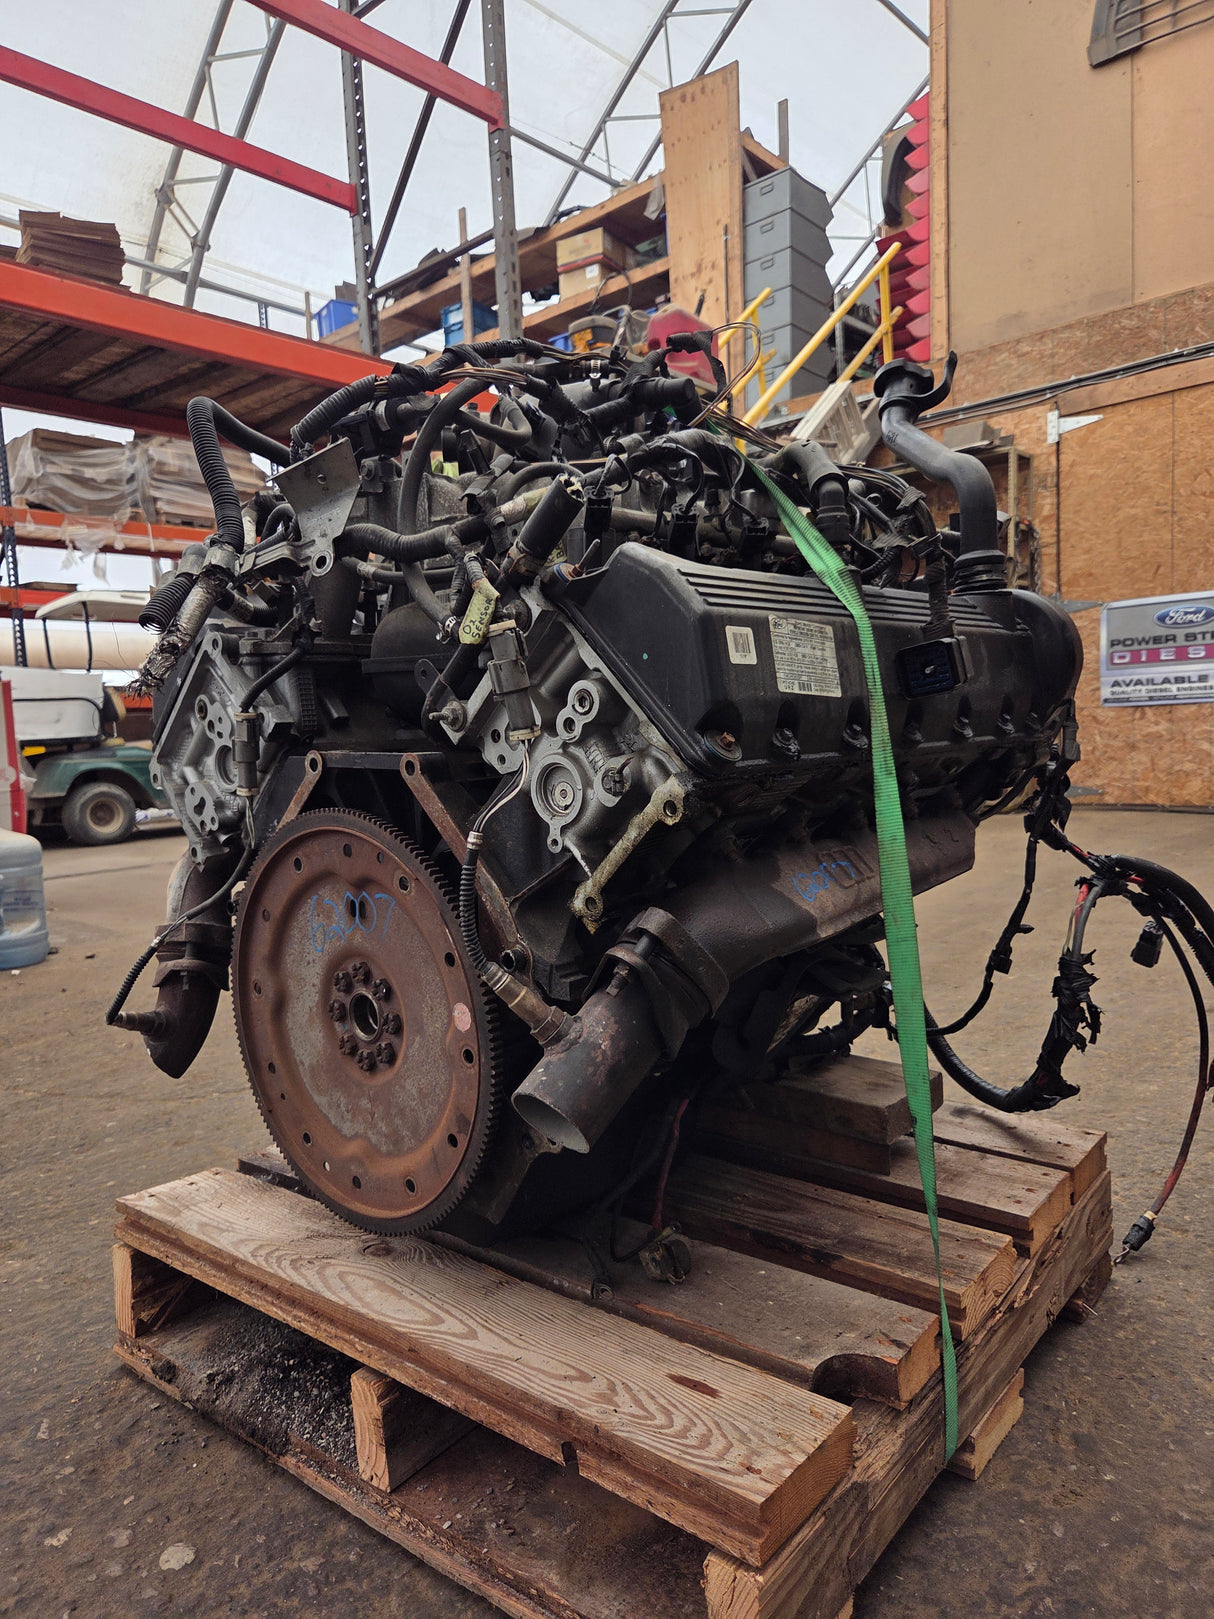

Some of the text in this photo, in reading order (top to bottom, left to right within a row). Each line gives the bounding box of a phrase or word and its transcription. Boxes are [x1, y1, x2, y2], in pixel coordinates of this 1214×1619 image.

[1165, 607, 1206, 625] Ford
[1110, 634, 1177, 647] POWER
[1112, 646, 1206, 664] DIES
[1111, 675, 1209, 688] AVAILABLE
[1109, 687, 1142, 696] QUALITY
[1145, 686, 1174, 694] DIESEL
[310, 890, 396, 953] 62007
